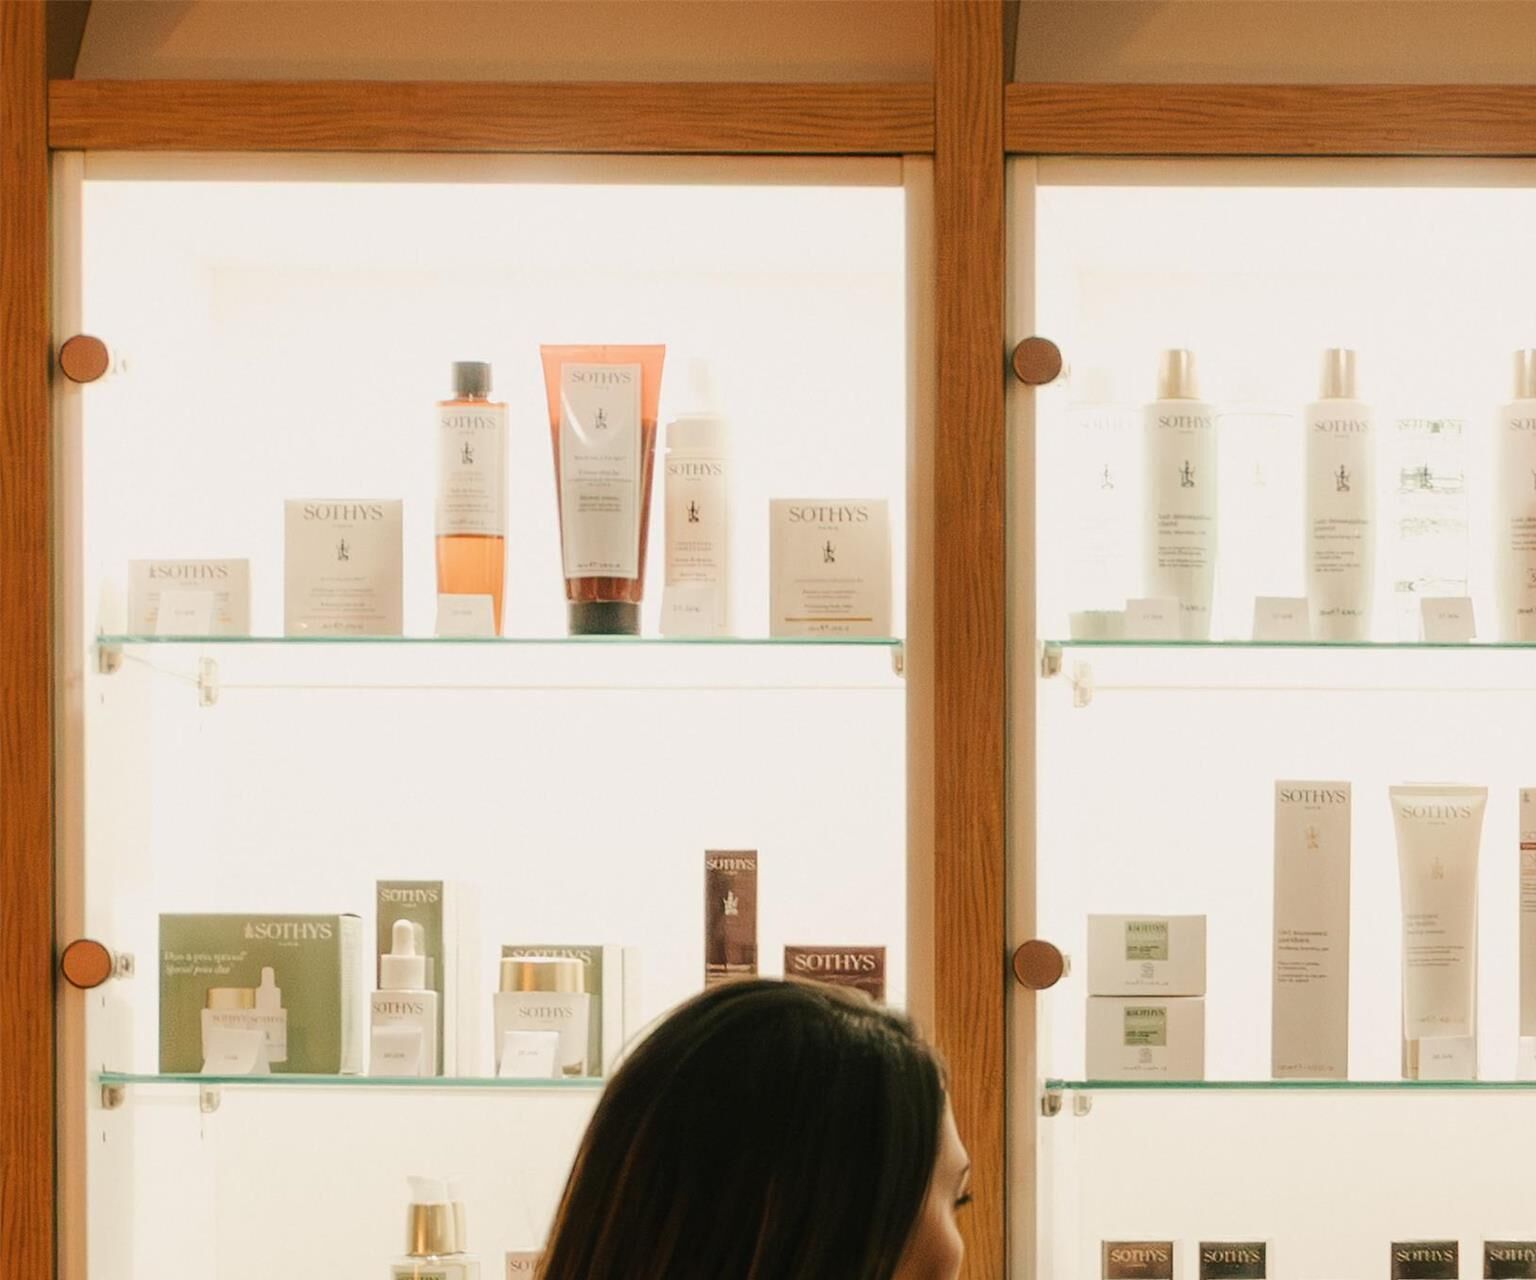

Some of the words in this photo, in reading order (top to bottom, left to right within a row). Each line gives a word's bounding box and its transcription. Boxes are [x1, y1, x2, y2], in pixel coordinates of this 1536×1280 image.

[571, 371, 632, 384] SOTHYS
[441, 415, 497, 429] SOTHYS
[1158, 415, 1212, 430] SOTHYS
[1314, 419, 1369, 433] SOTHYS
[667, 463, 722, 476] SOTHYS
[304, 504, 384, 521] SOTHYS
[789, 505, 869, 522] SOTHYS
[156, 564, 229, 579] SOTHYS
[1279, 789, 1346, 804] SOTHYS
[1401, 805, 1472, 820] SOTHYS
[706, 858, 756, 871] SOTHYS
[379, 888, 438, 903] SOTHYS
[256, 922, 333, 939] SOTHYS
[793, 954, 876, 972] SOTHYS
[371, 1001, 424, 1016] SOTHYS
[519, 1006, 574, 1018] SOTHYS
[1111, 1248, 1167, 1263] SOTHYS
[1204, 1250, 1261, 1263] SOTHYS
[1396, 1249, 1454, 1262] SOTHYS
